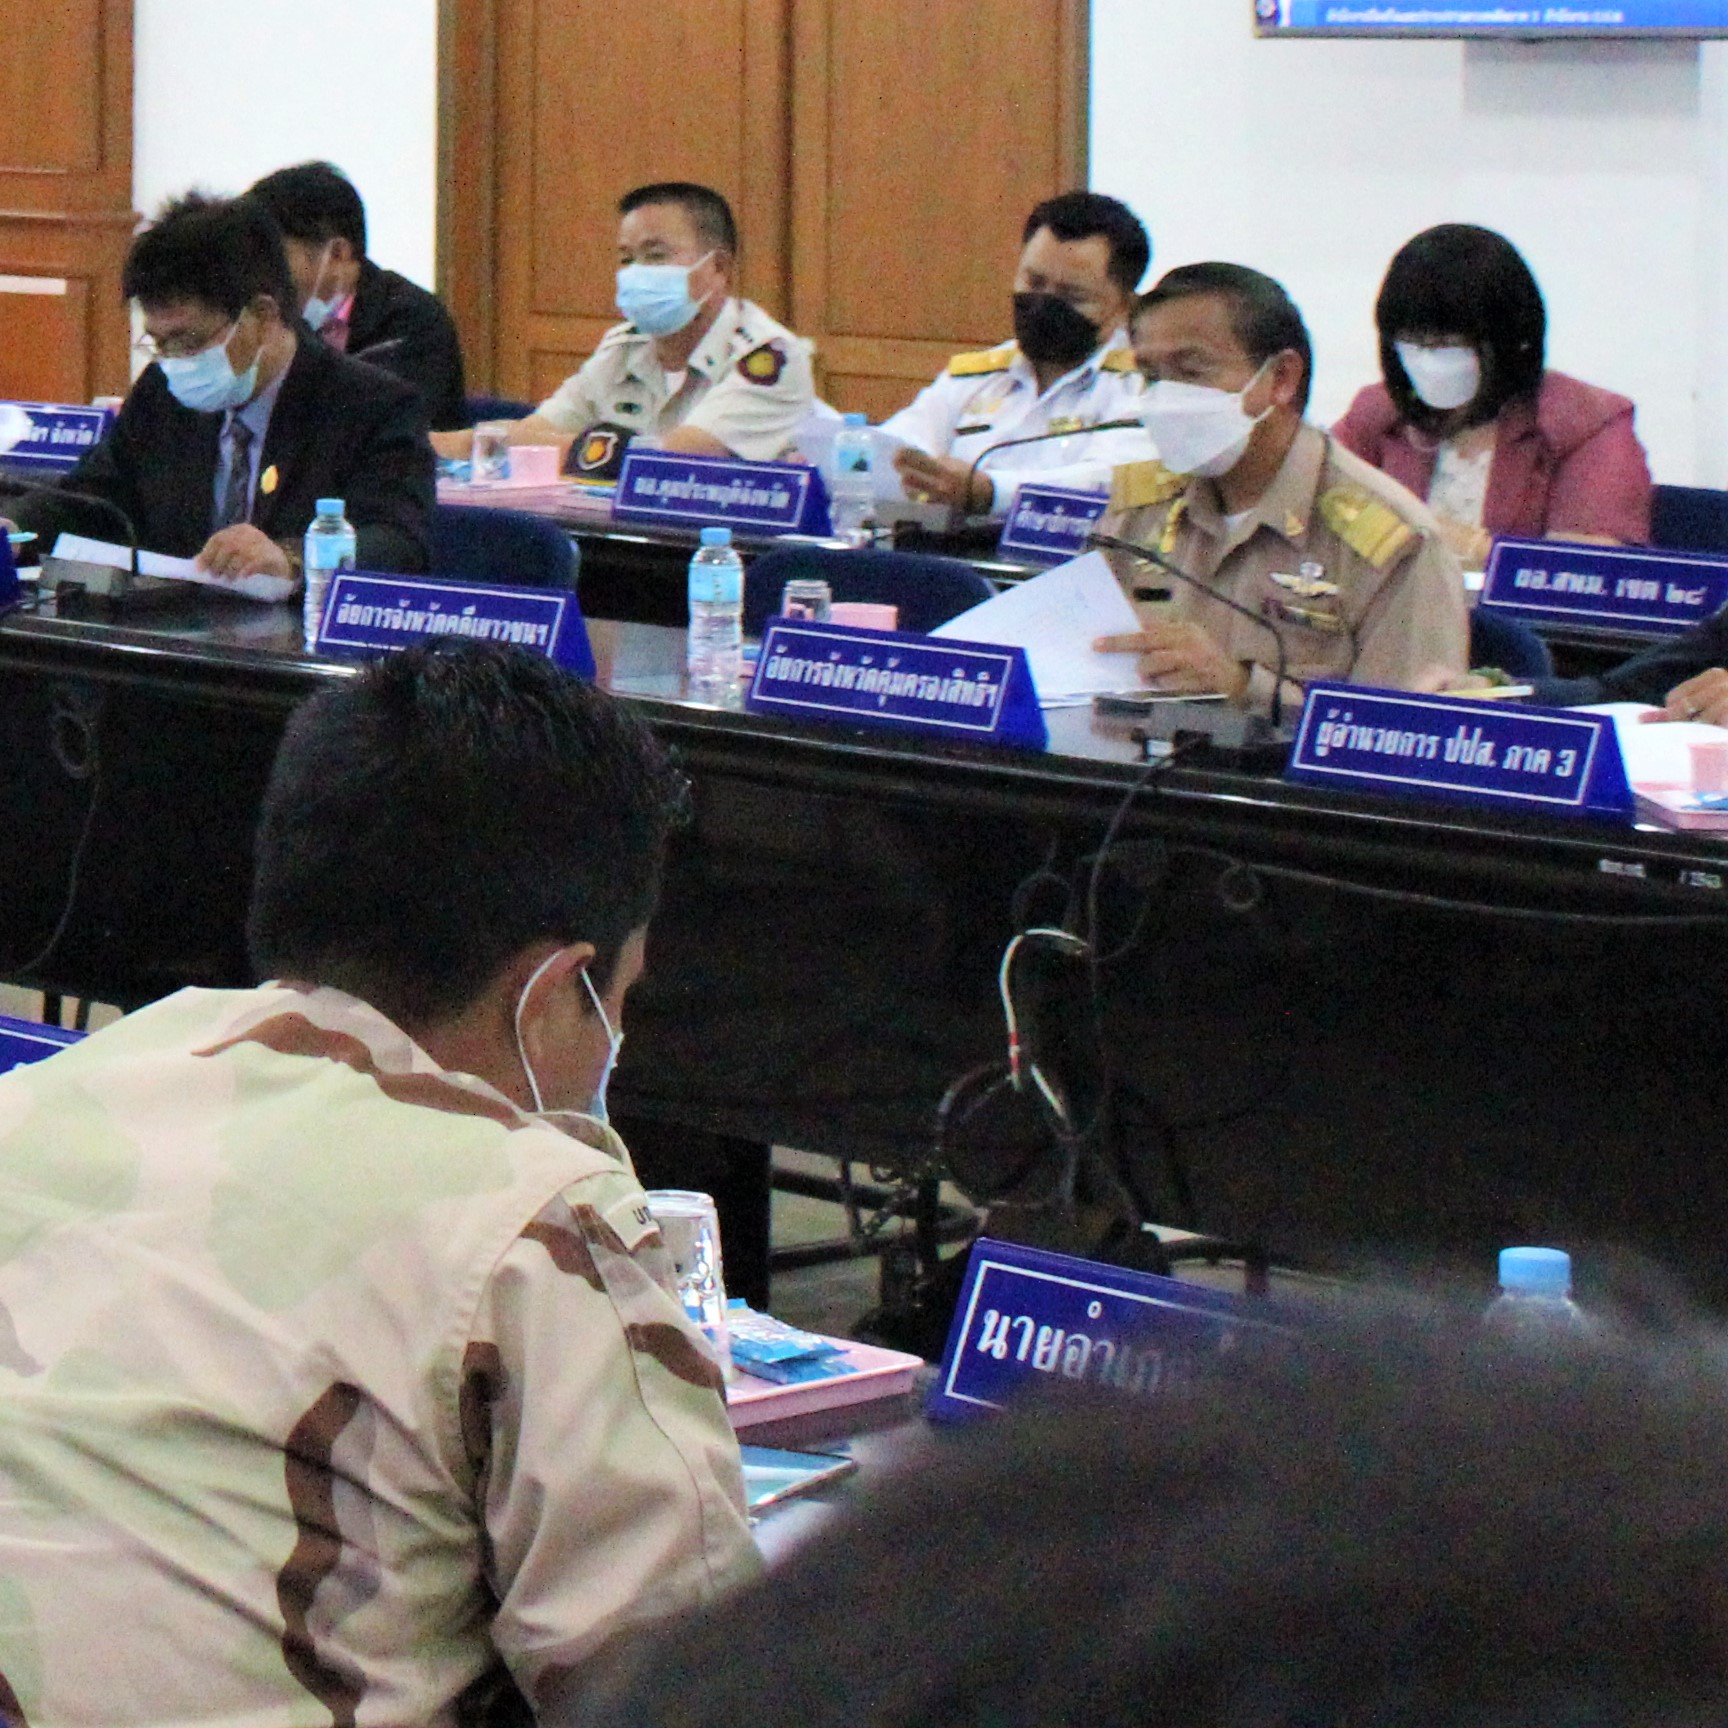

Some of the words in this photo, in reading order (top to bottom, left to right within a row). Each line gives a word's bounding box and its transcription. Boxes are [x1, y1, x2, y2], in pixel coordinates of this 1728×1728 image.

[1315, 708, 1441, 760] ผู้อำนวยการ
[1502, 744, 1551, 774] ภาค
[1555, 749, 1578, 778] 3
